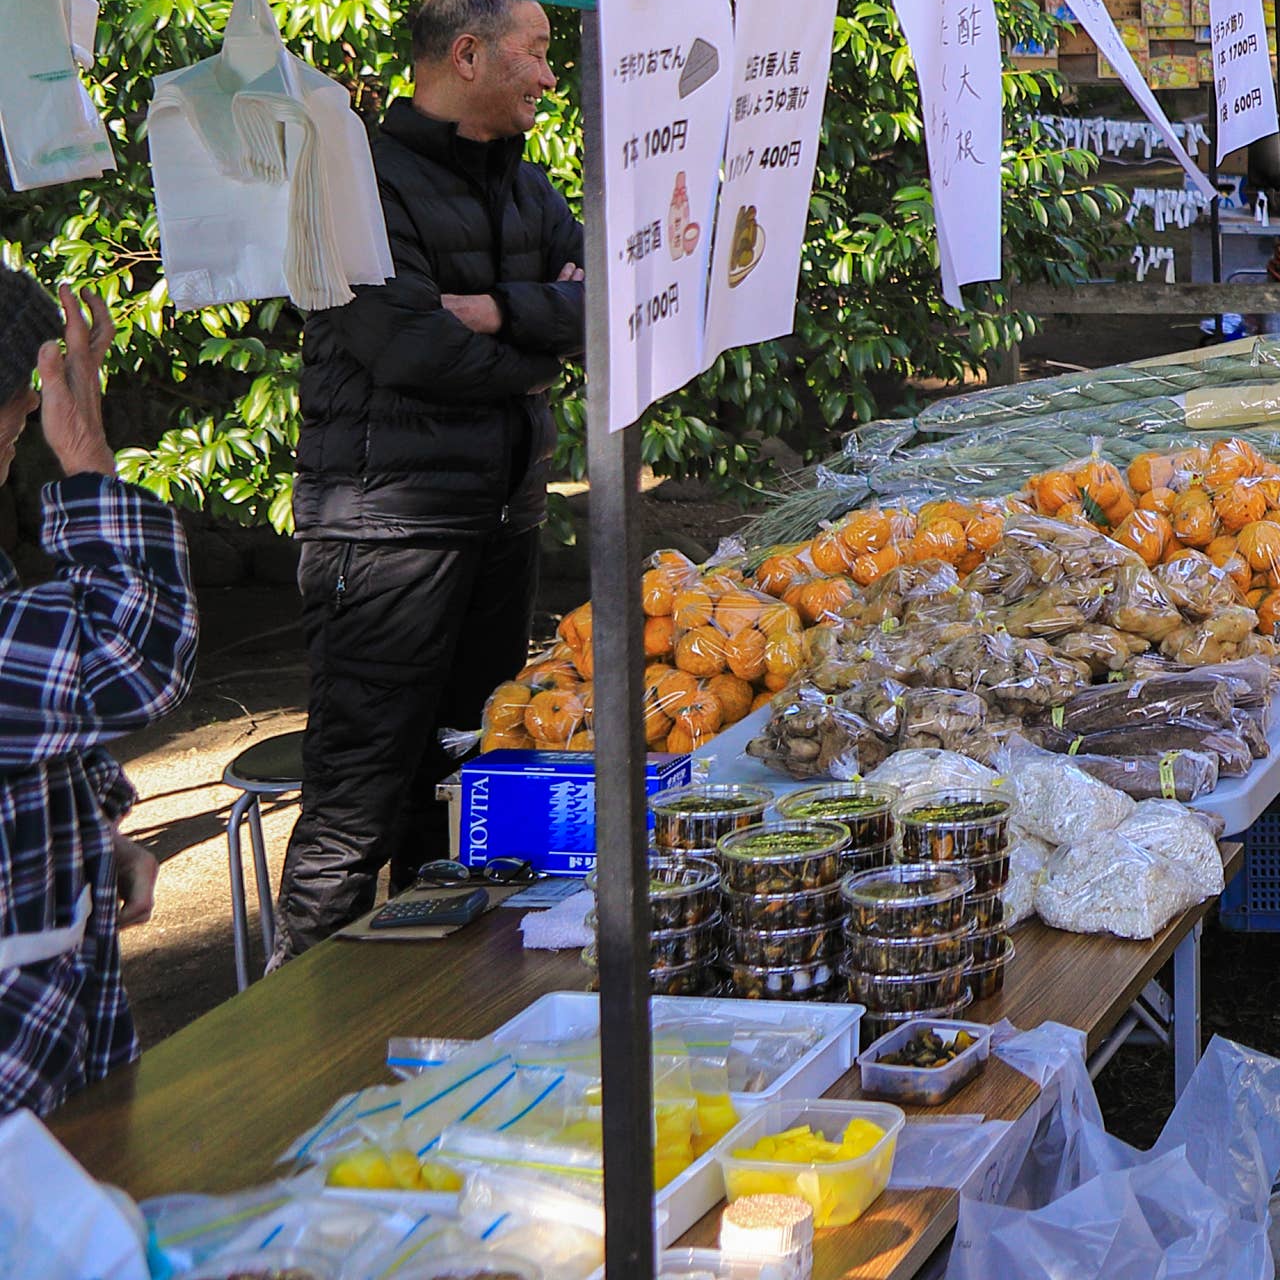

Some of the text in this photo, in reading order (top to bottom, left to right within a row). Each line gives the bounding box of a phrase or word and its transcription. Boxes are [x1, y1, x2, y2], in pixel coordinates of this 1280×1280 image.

[620, 45, 686, 83] 手作りおでん
[1228, 33, 1258, 64] 1700円
[1233, 87, 1262, 116] 600円
[644, 118, 689, 160] 100円
[759, 139, 802, 170] 400円
[646, 281, 679, 327] 100円
[469, 776, 490, 866] TIOVITA
